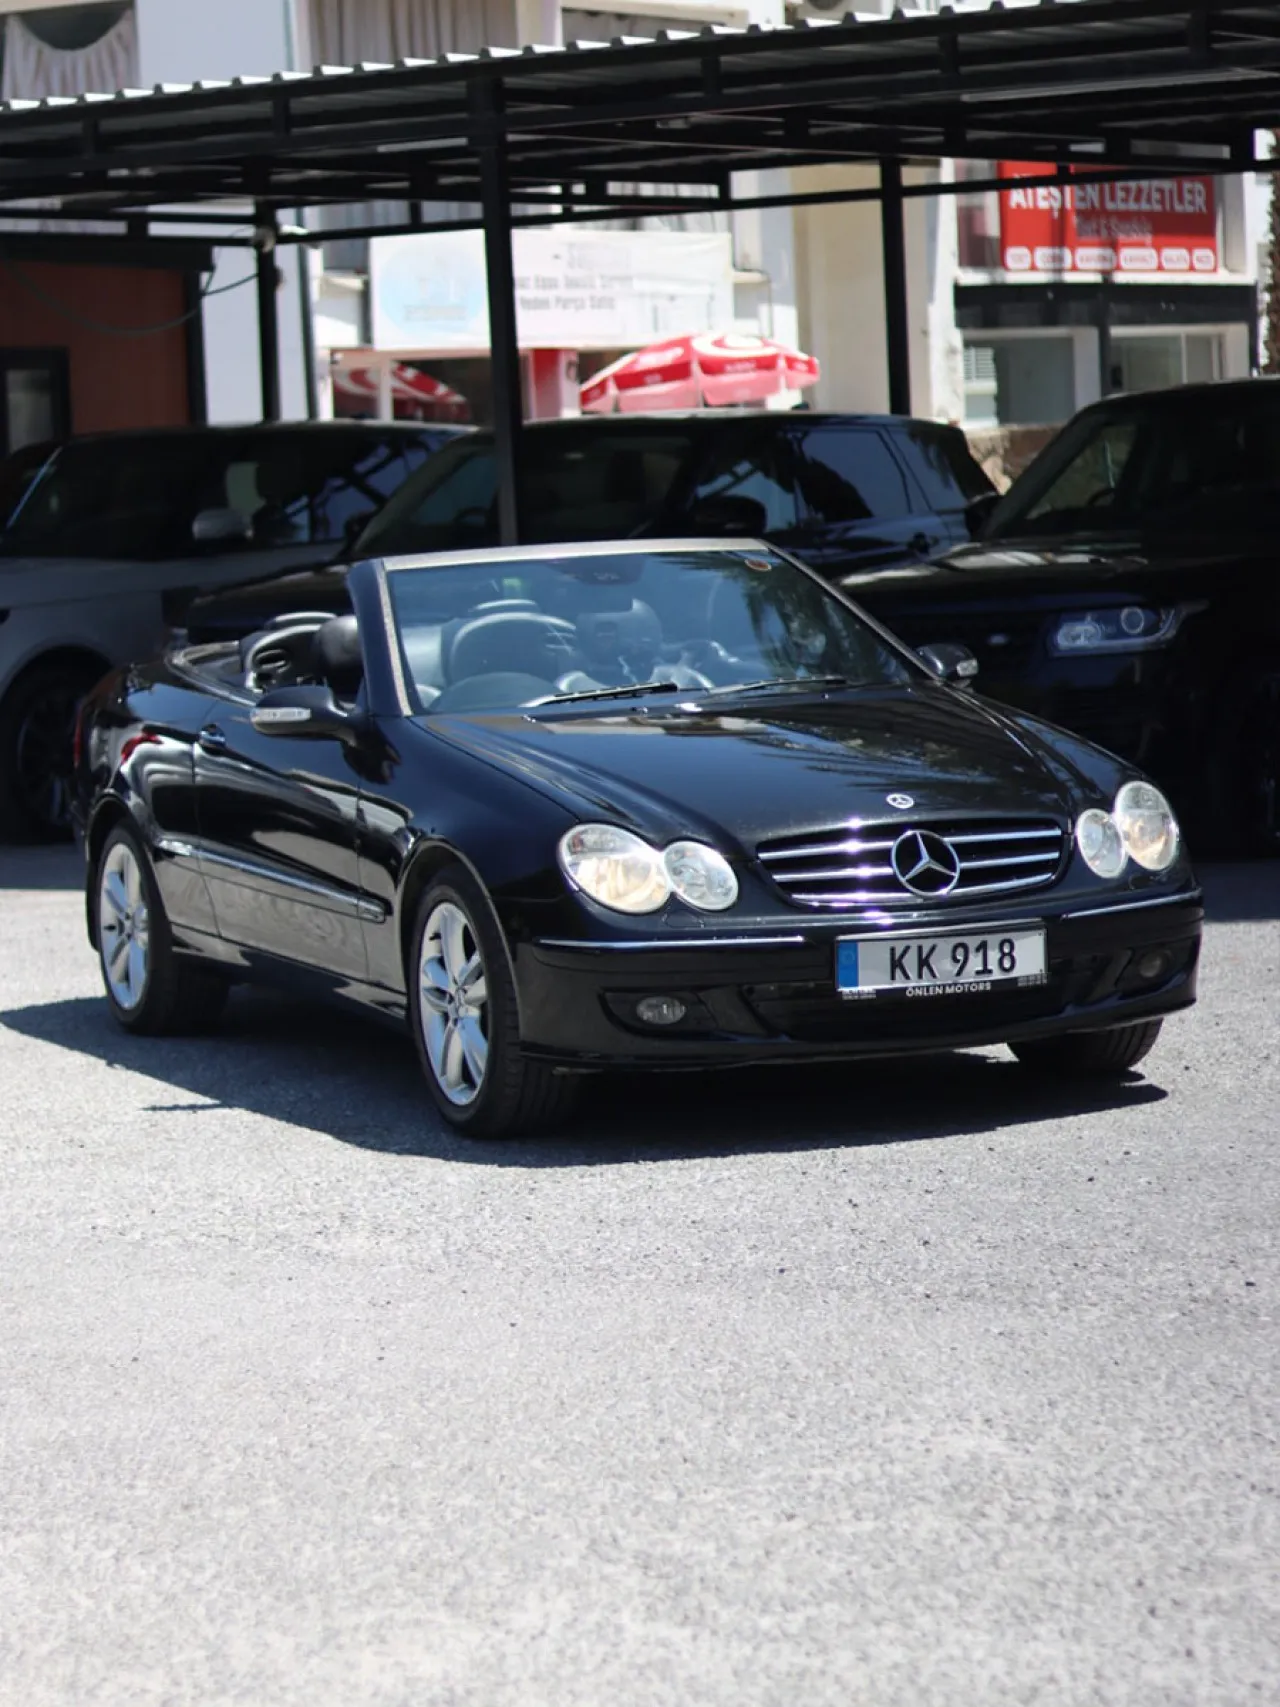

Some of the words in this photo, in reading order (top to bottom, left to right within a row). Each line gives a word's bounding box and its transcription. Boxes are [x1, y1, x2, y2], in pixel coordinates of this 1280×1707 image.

[1104, 178, 1207, 217] LEZZETLER
[889, 944, 939, 981] KK
[951, 938, 1017, 977] 918
[945, 982, 992, 994] MOTORS
